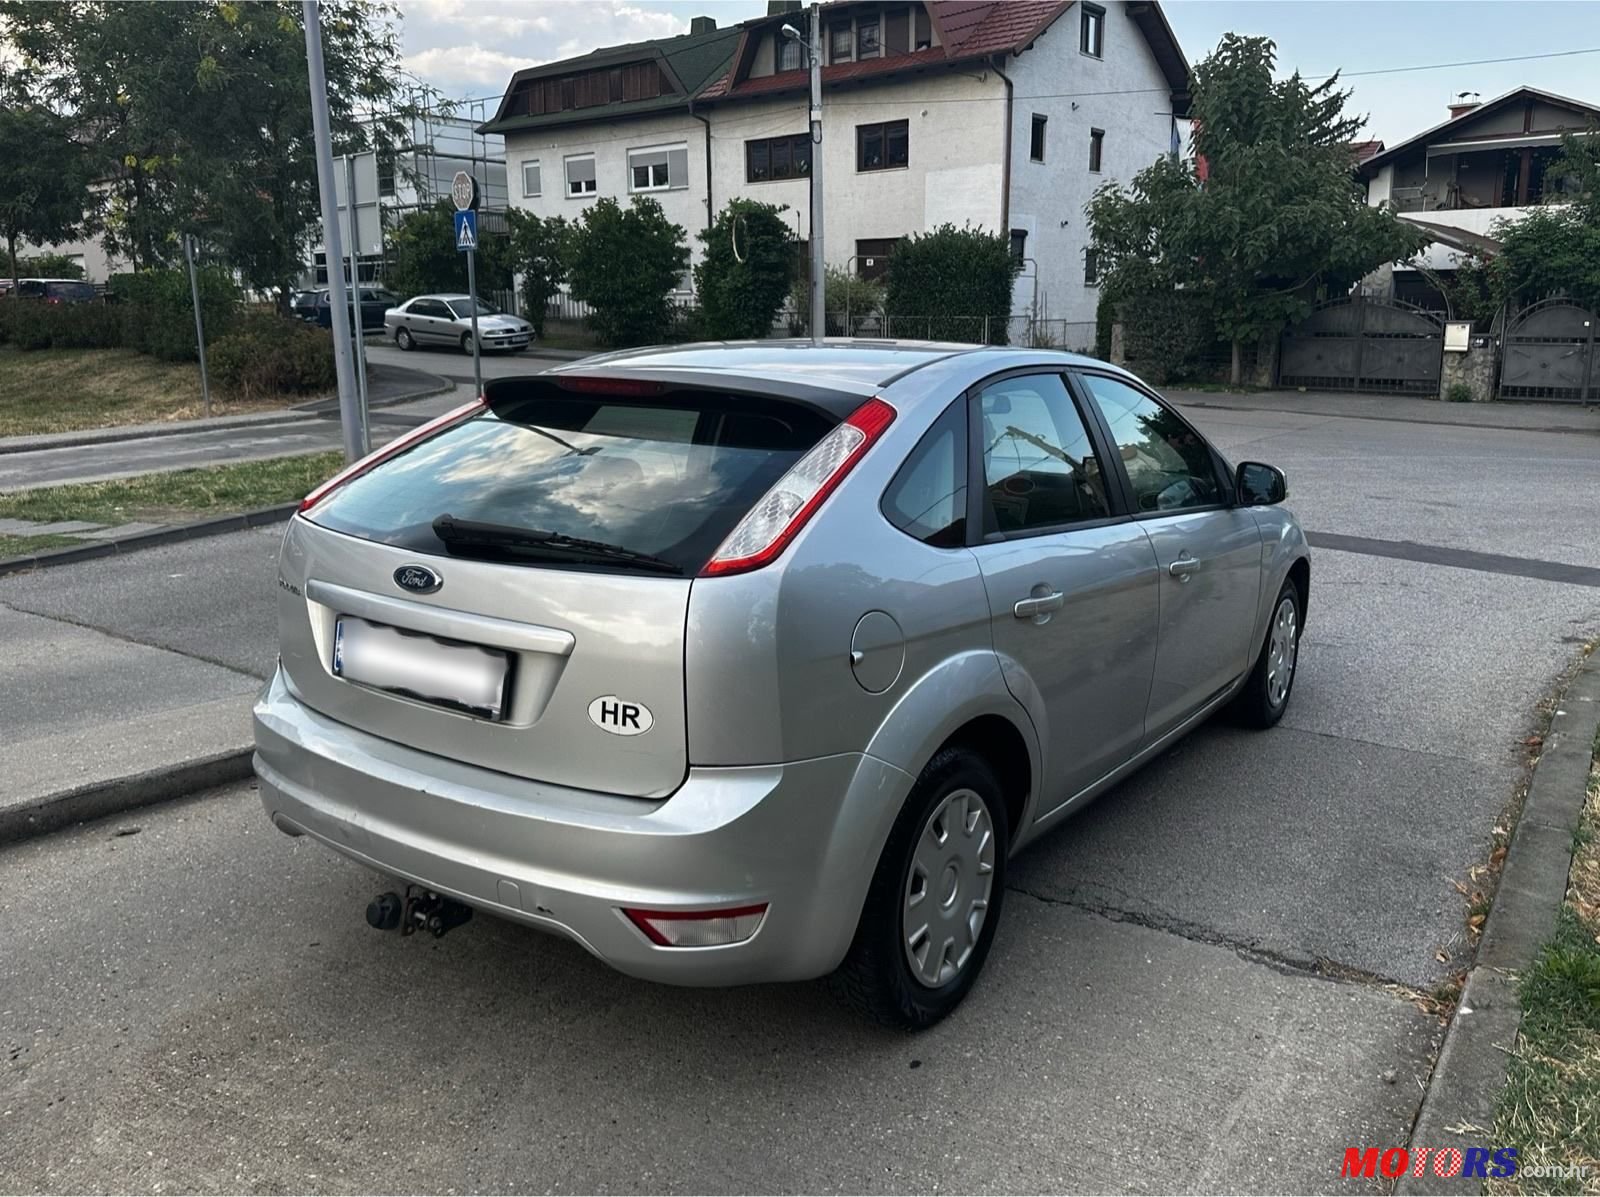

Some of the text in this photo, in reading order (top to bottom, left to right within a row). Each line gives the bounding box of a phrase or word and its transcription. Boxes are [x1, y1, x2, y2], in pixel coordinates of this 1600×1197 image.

[454, 184, 470, 200] STOP
[401, 569, 428, 587] Ford
[601, 701, 640, 729] HR
